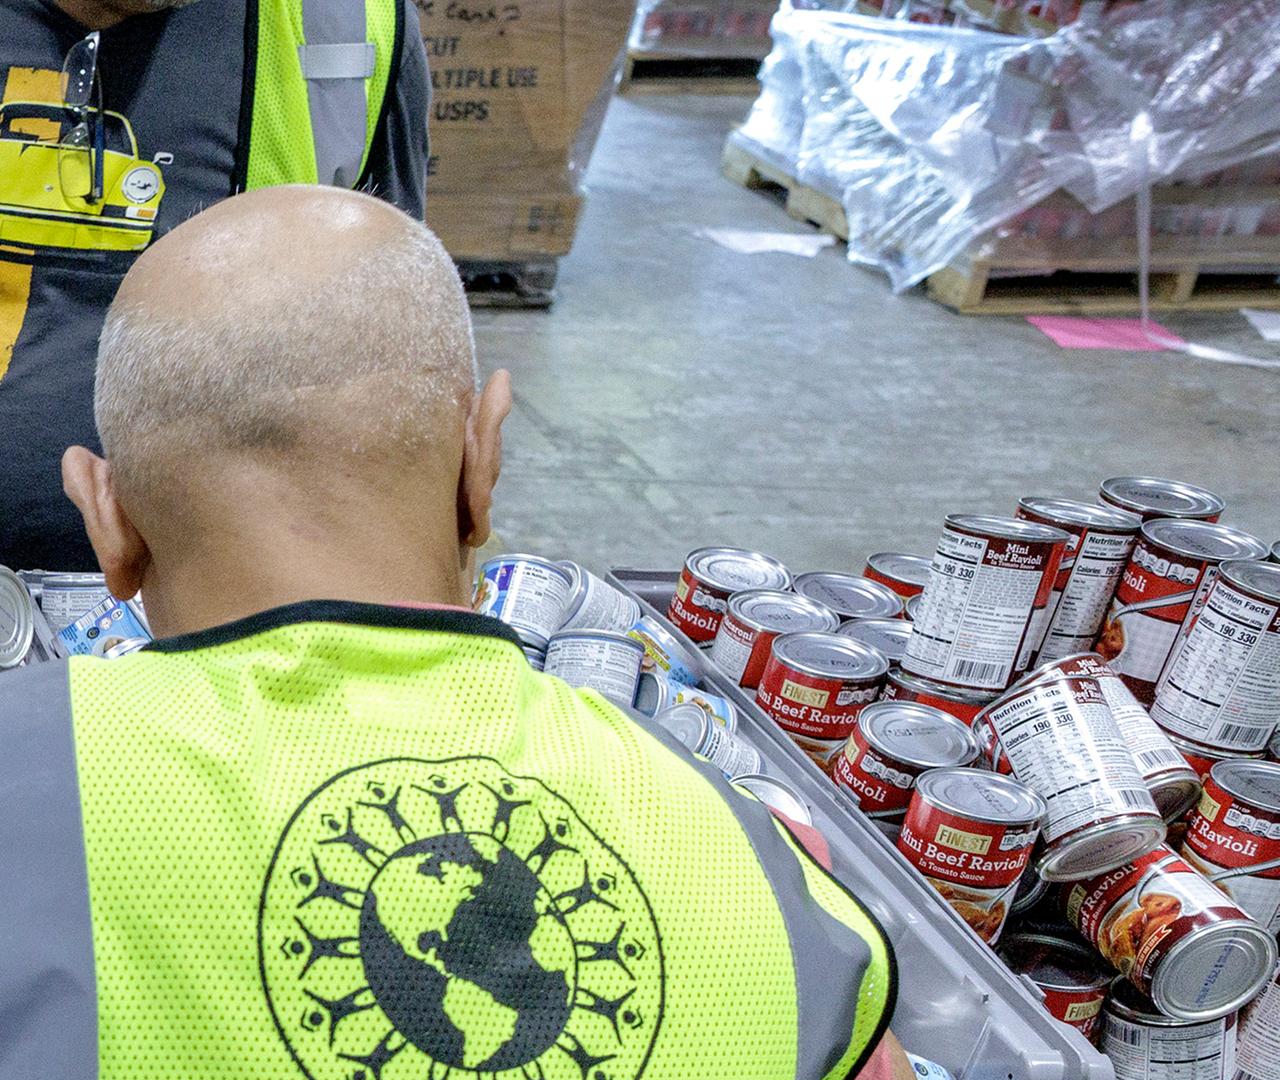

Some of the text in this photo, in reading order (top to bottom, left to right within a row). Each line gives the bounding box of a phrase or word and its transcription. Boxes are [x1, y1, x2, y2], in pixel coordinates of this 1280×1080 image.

[431, 67, 501, 88] LTIPLE
[435, 100, 489, 121] USPS
[960, 538, 983, 549] Facts
[1006, 543, 1029, 554] Mini
[1089, 536, 1124, 546] Nutrition
[987, 550, 1042, 565] Beef Ravioli
[944, 563, 974, 579] 190 330
[1077, 565, 1101, 574] Calories
[676, 602, 718, 631] Ravioli
[1244, 600, 1271, 616] Facts
[1219, 624, 1257, 645] 190 330
[784, 684, 826, 705] FINEST
[994, 689, 1061, 721] Nutrition Fcts
[772, 698, 860, 724] Beef Raviol
[1005, 713, 1073, 748] Calories 190 330
[841, 762, 887, 802] Ravioli
[900, 824, 1025, 872] Mini Beef Ravioli
[939, 829, 989, 851] FINEST
[1198, 820, 1258, 857] Ravioli
[928, 860, 958, 877] Tomato
[960, 871, 985, 881] Sauce
[1089, 864, 1138, 911] Ravioli
